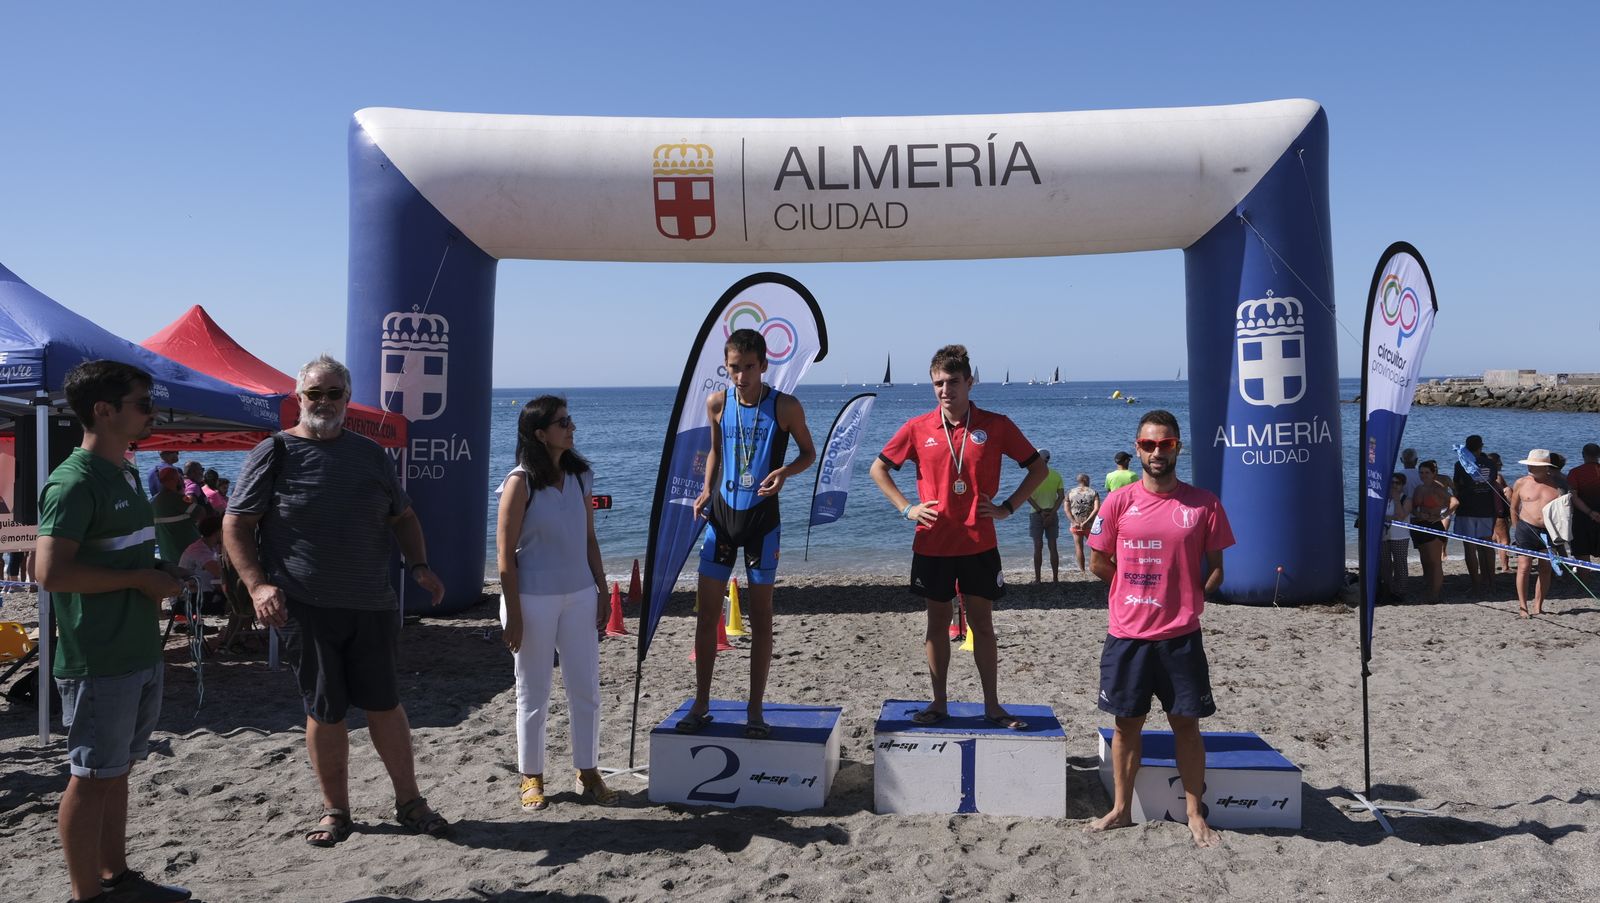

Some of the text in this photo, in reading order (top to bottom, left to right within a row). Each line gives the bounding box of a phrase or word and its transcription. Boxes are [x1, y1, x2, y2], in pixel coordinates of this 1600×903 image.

[773, 133, 1042, 191] ALMERÍA
[774, 202, 908, 231] CIUDAD
[1377, 343, 1407, 370] circuitos
[1213, 415, 1332, 447] ALMERÍA
[821, 425, 847, 485] DEPORTE
[1241, 448, 1310, 465] CIUDAD
[1, 534, 38, 544] @montur
[1124, 572, 1162, 581] ECOSPORT
[687, 744, 741, 804] 2
[951, 738, 981, 813] 1
